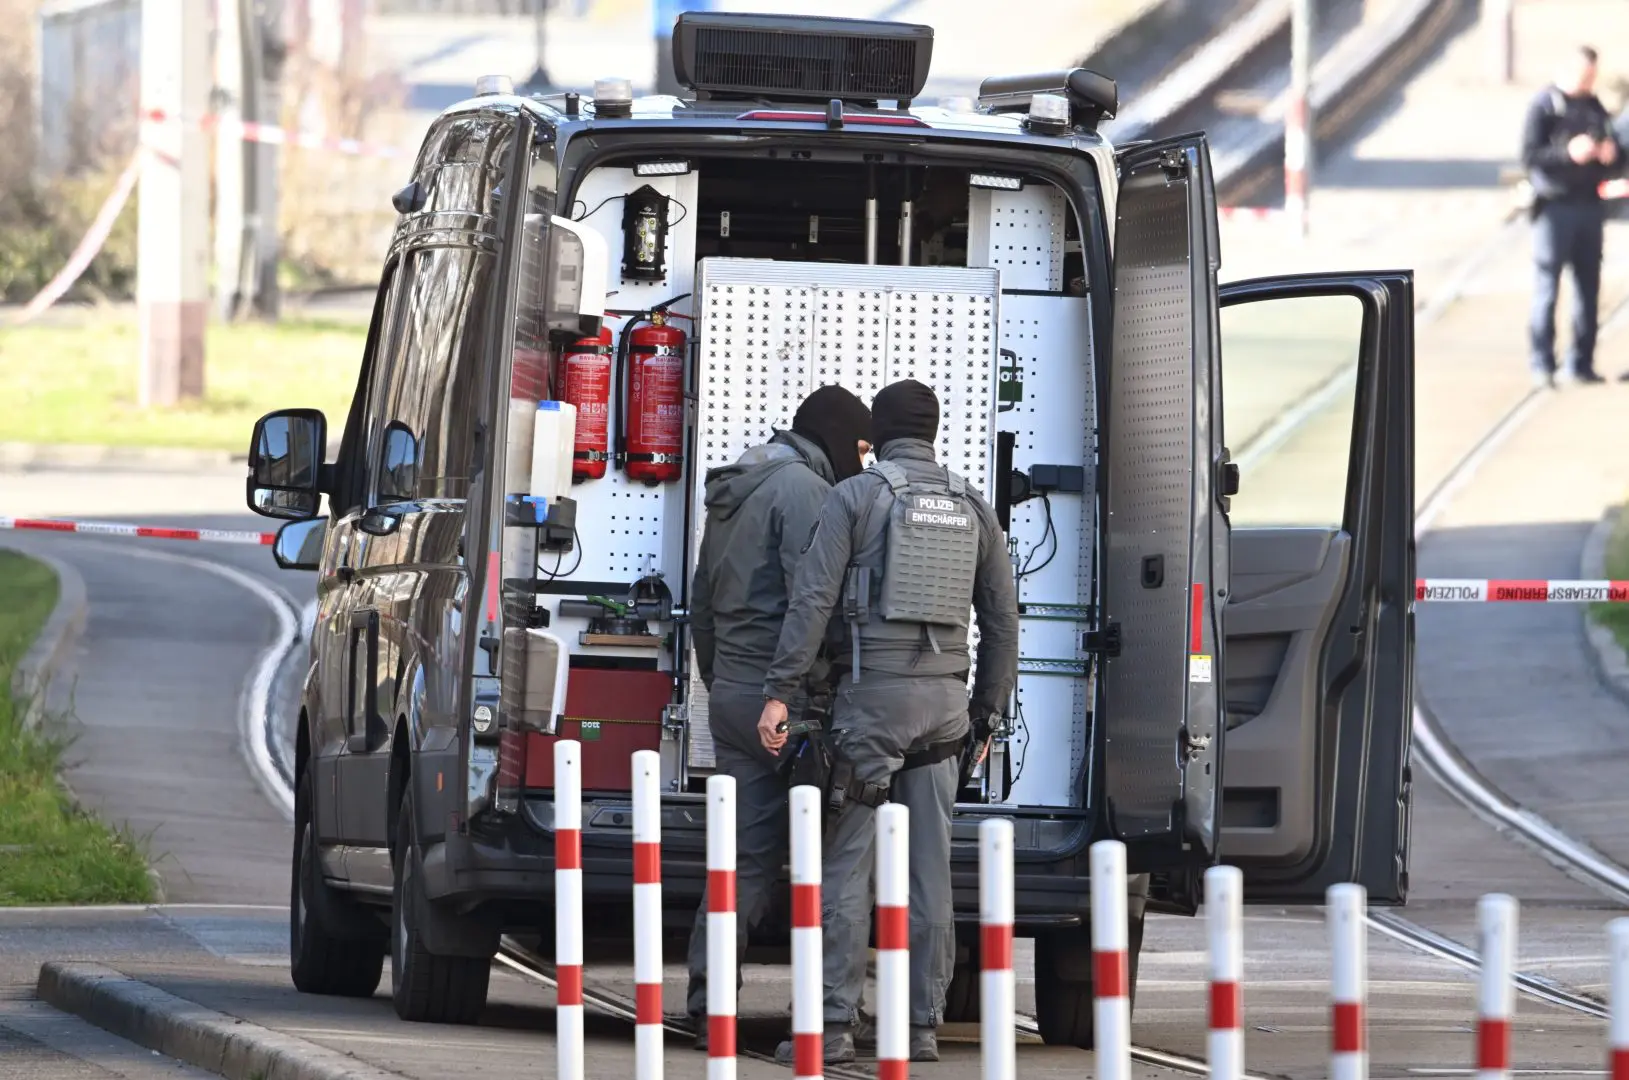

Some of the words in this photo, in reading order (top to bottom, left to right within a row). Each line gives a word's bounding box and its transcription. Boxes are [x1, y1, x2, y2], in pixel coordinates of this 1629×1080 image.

[919, 498, 954, 511] POLIZEI
[912, 512, 967, 527] ENTSCHÄRFER
[1497, 587, 1627, 600] POLIZEIABSPERRUNG
